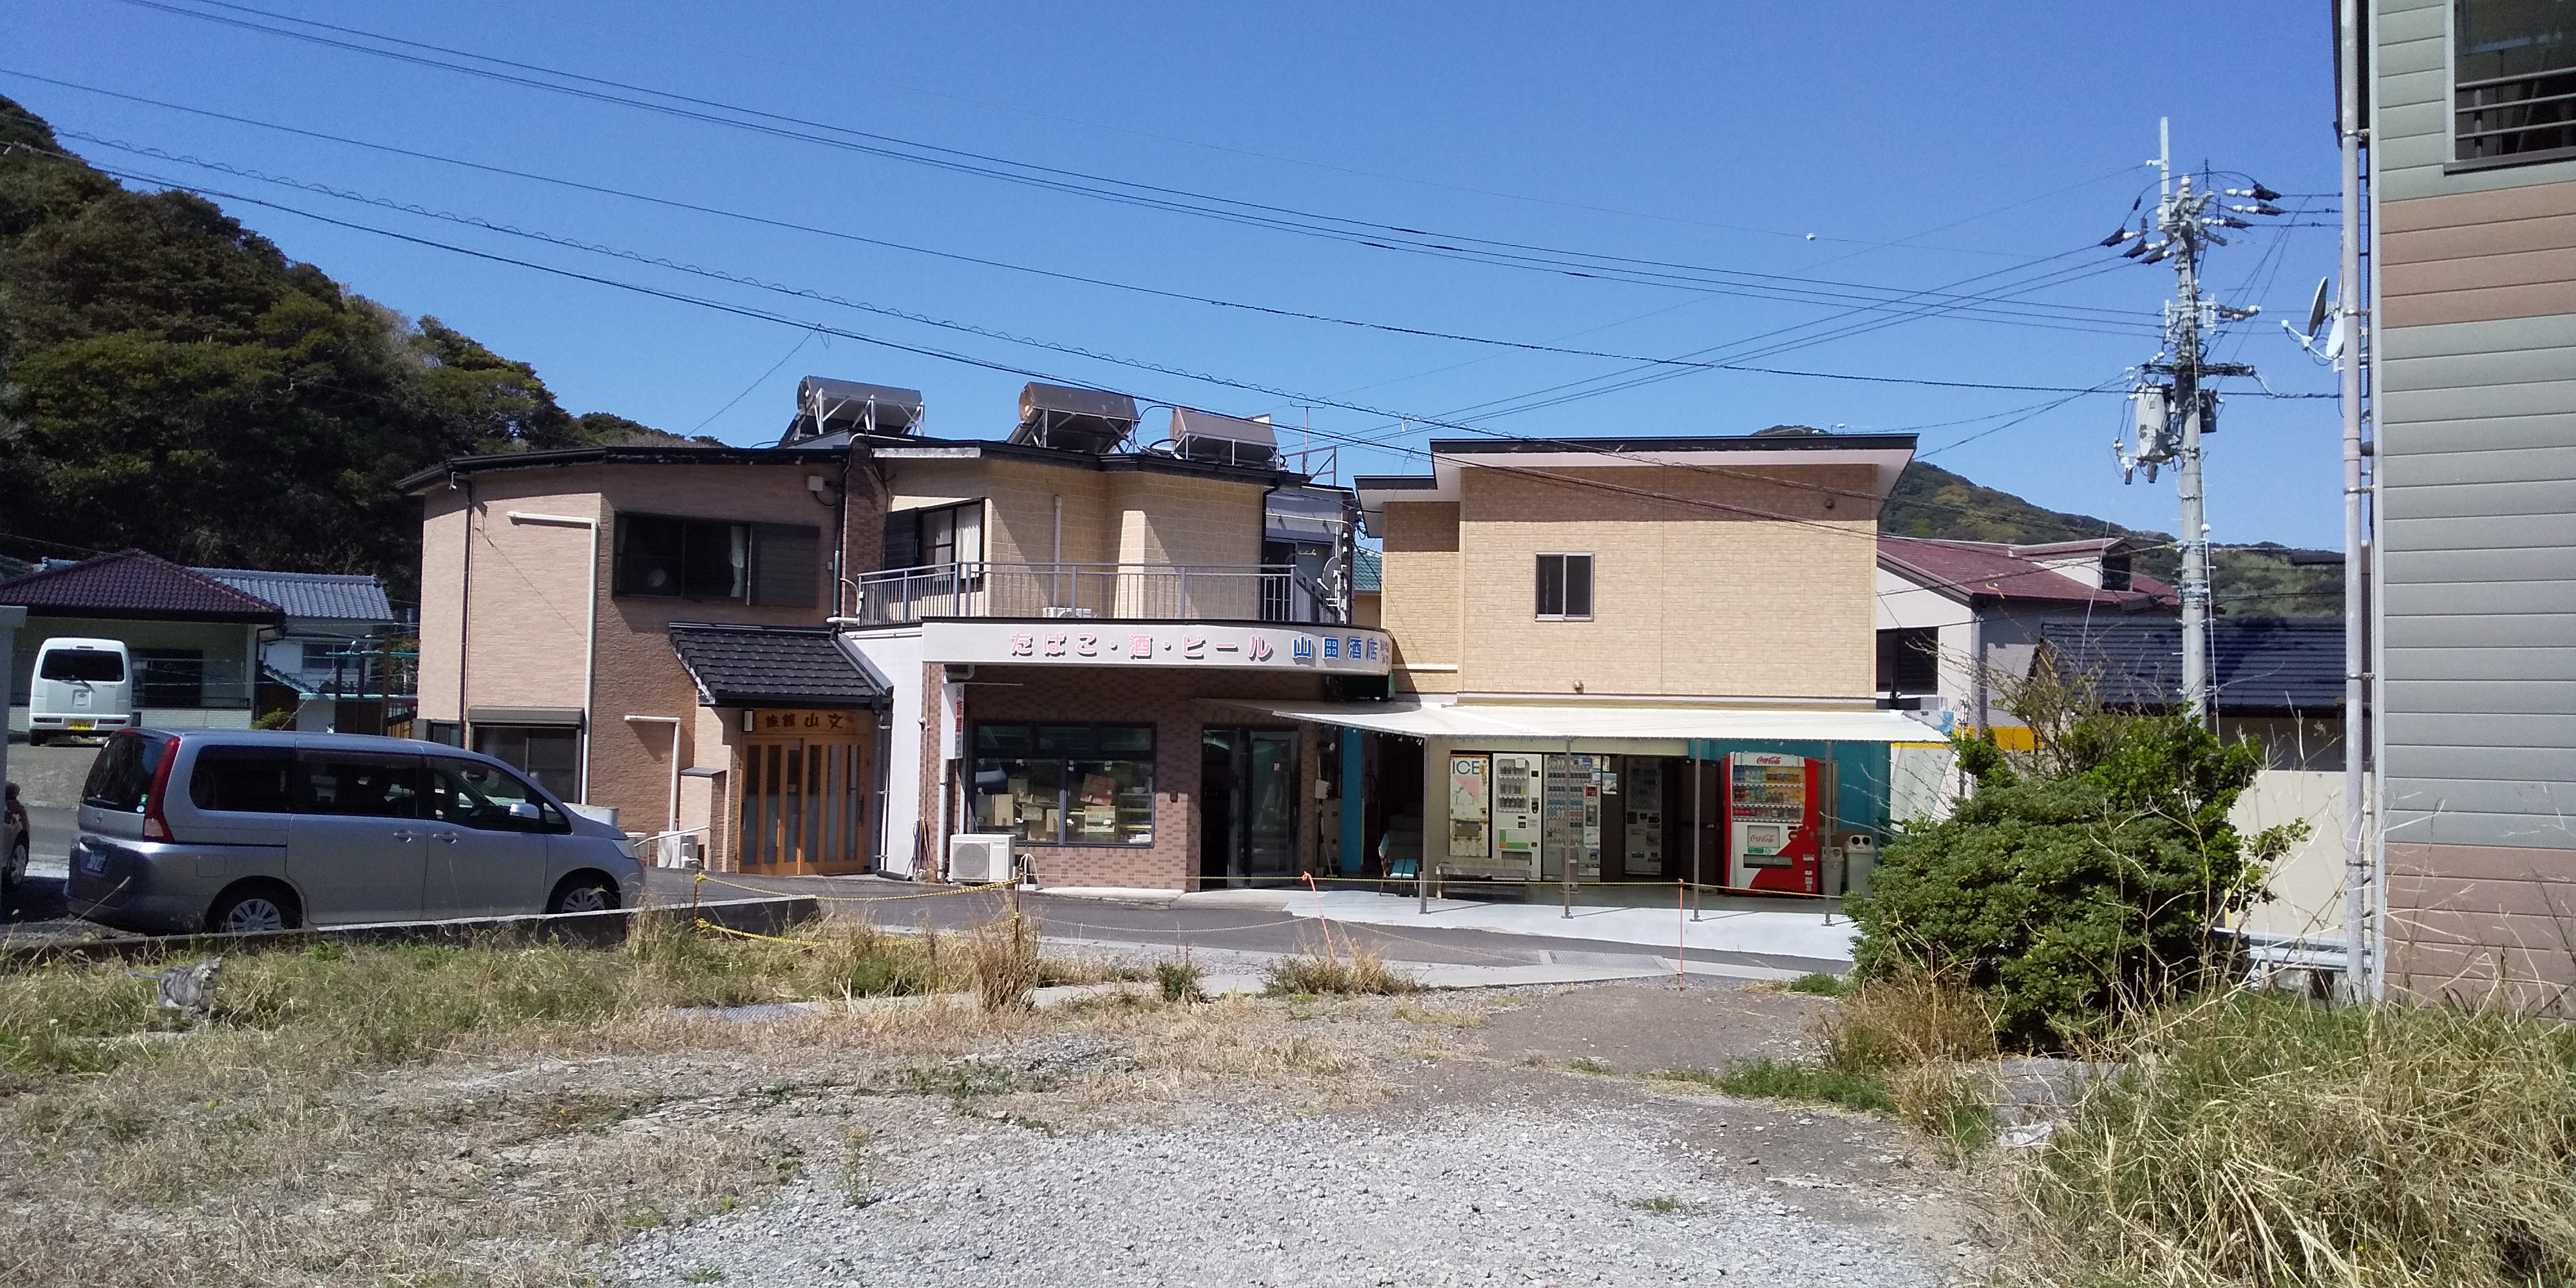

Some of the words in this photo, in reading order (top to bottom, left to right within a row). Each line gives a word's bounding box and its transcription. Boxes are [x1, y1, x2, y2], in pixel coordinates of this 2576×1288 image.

[1293, 636, 1378, 662] 山田酒店
[1452, 760, 1480, 775] ICE
